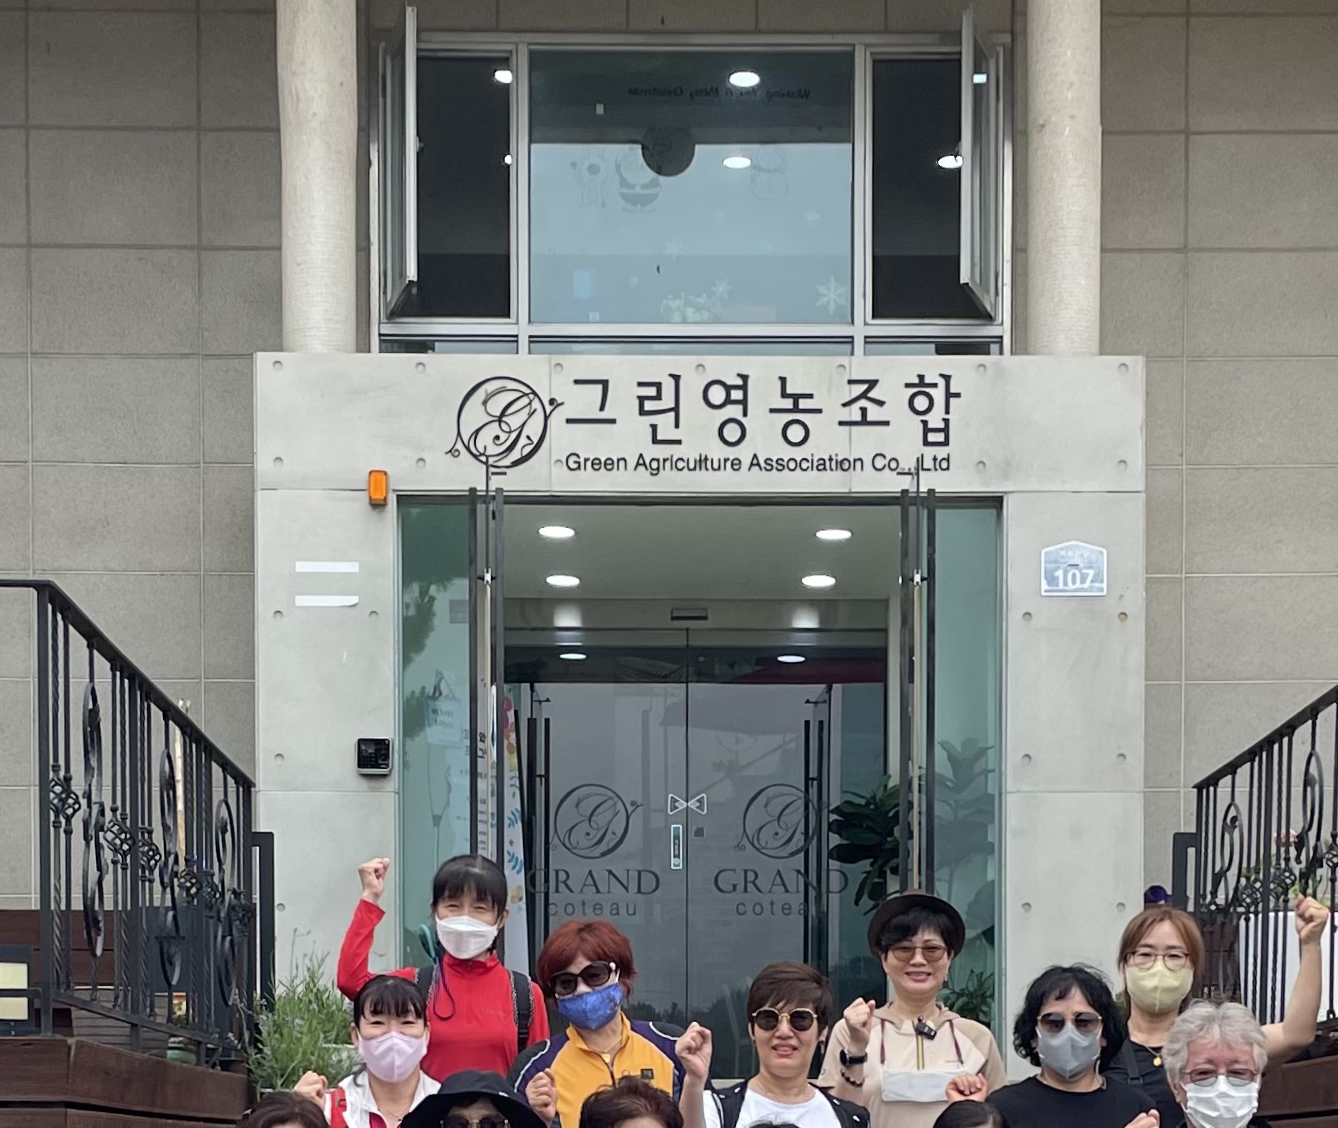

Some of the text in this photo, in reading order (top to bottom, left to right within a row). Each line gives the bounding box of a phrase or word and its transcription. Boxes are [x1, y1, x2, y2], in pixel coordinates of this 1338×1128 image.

[565, 372, 962, 447] 그린영농조합
[565, 453, 628, 473] Green
[634, 452, 743, 476] Agriculture
[748, 452, 864, 473] Association
[920, 453, 951, 472] Ltd
[1053, 569, 1095, 589] 107
[528, 868, 661, 895] GRAND
[714, 868, 849, 895] GRAND
[548, 900, 637, 917] coteau
[735, 900, 809, 917] cotea
